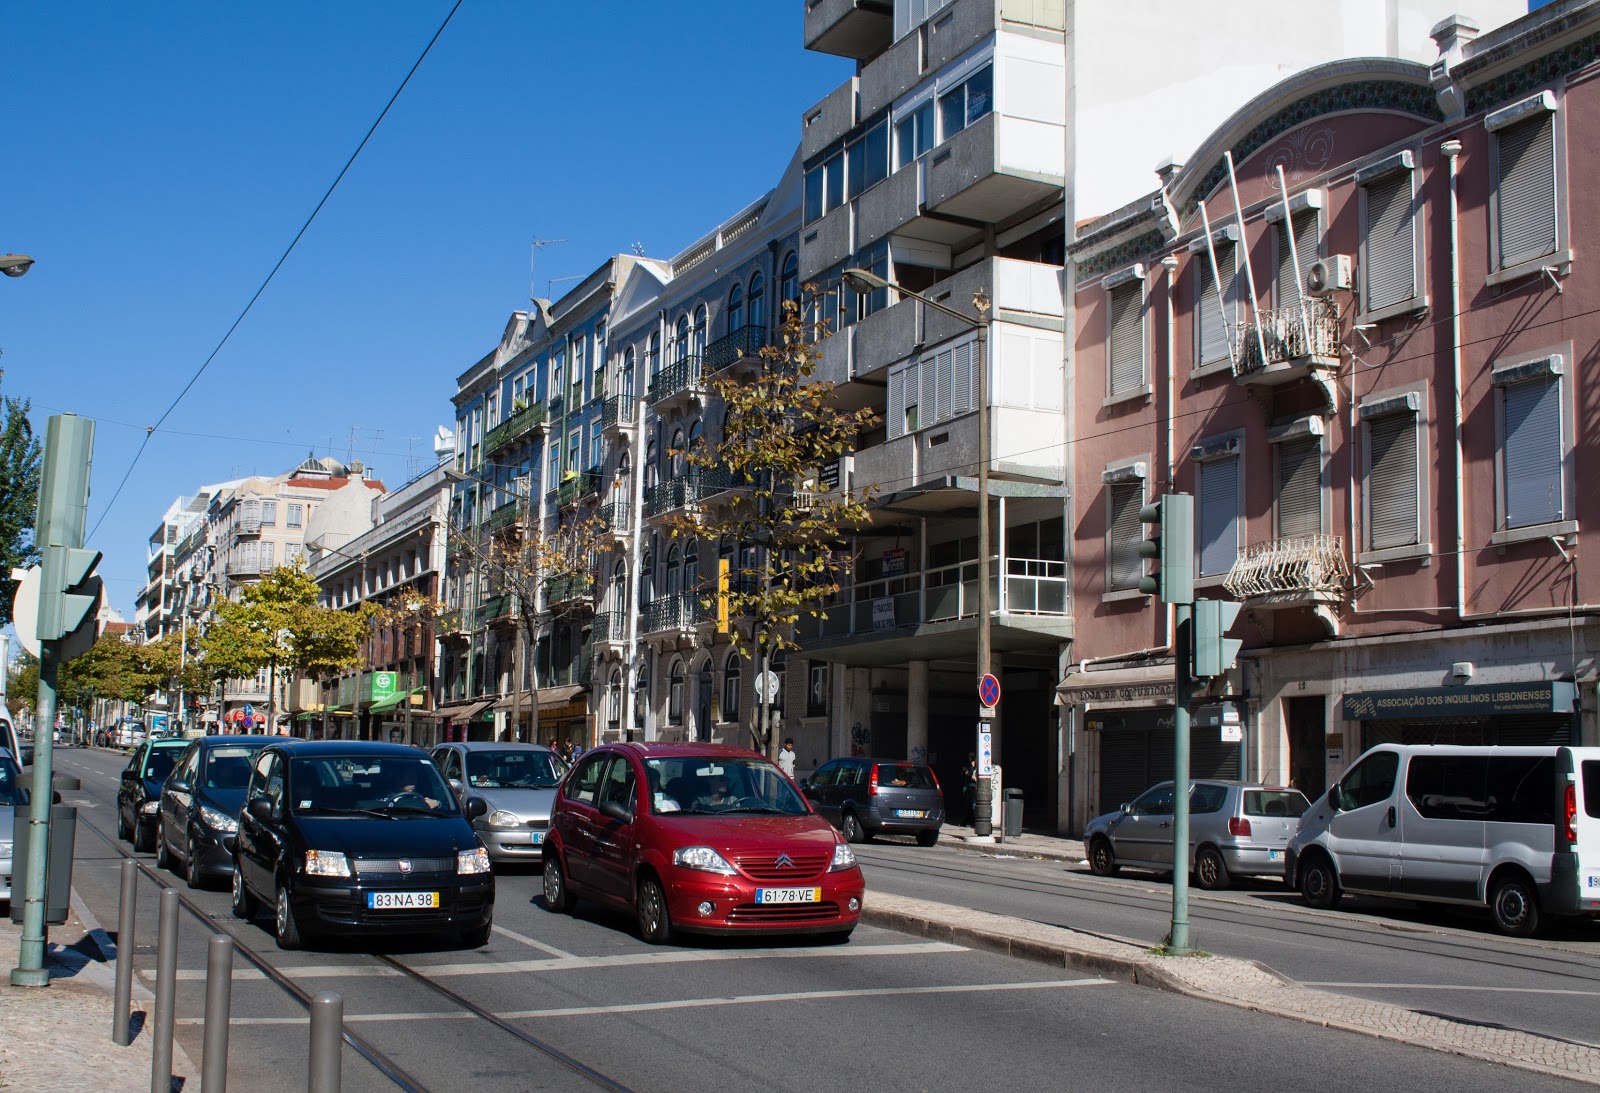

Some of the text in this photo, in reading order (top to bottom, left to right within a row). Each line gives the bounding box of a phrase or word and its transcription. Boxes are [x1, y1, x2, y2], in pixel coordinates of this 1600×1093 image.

[1080, 684, 1176, 700] LOJA DE COMUNICAÇ
[1377, 690, 1551, 708] ASSOCIAÇÃO DOS INQUILINOS LISBONENSES
